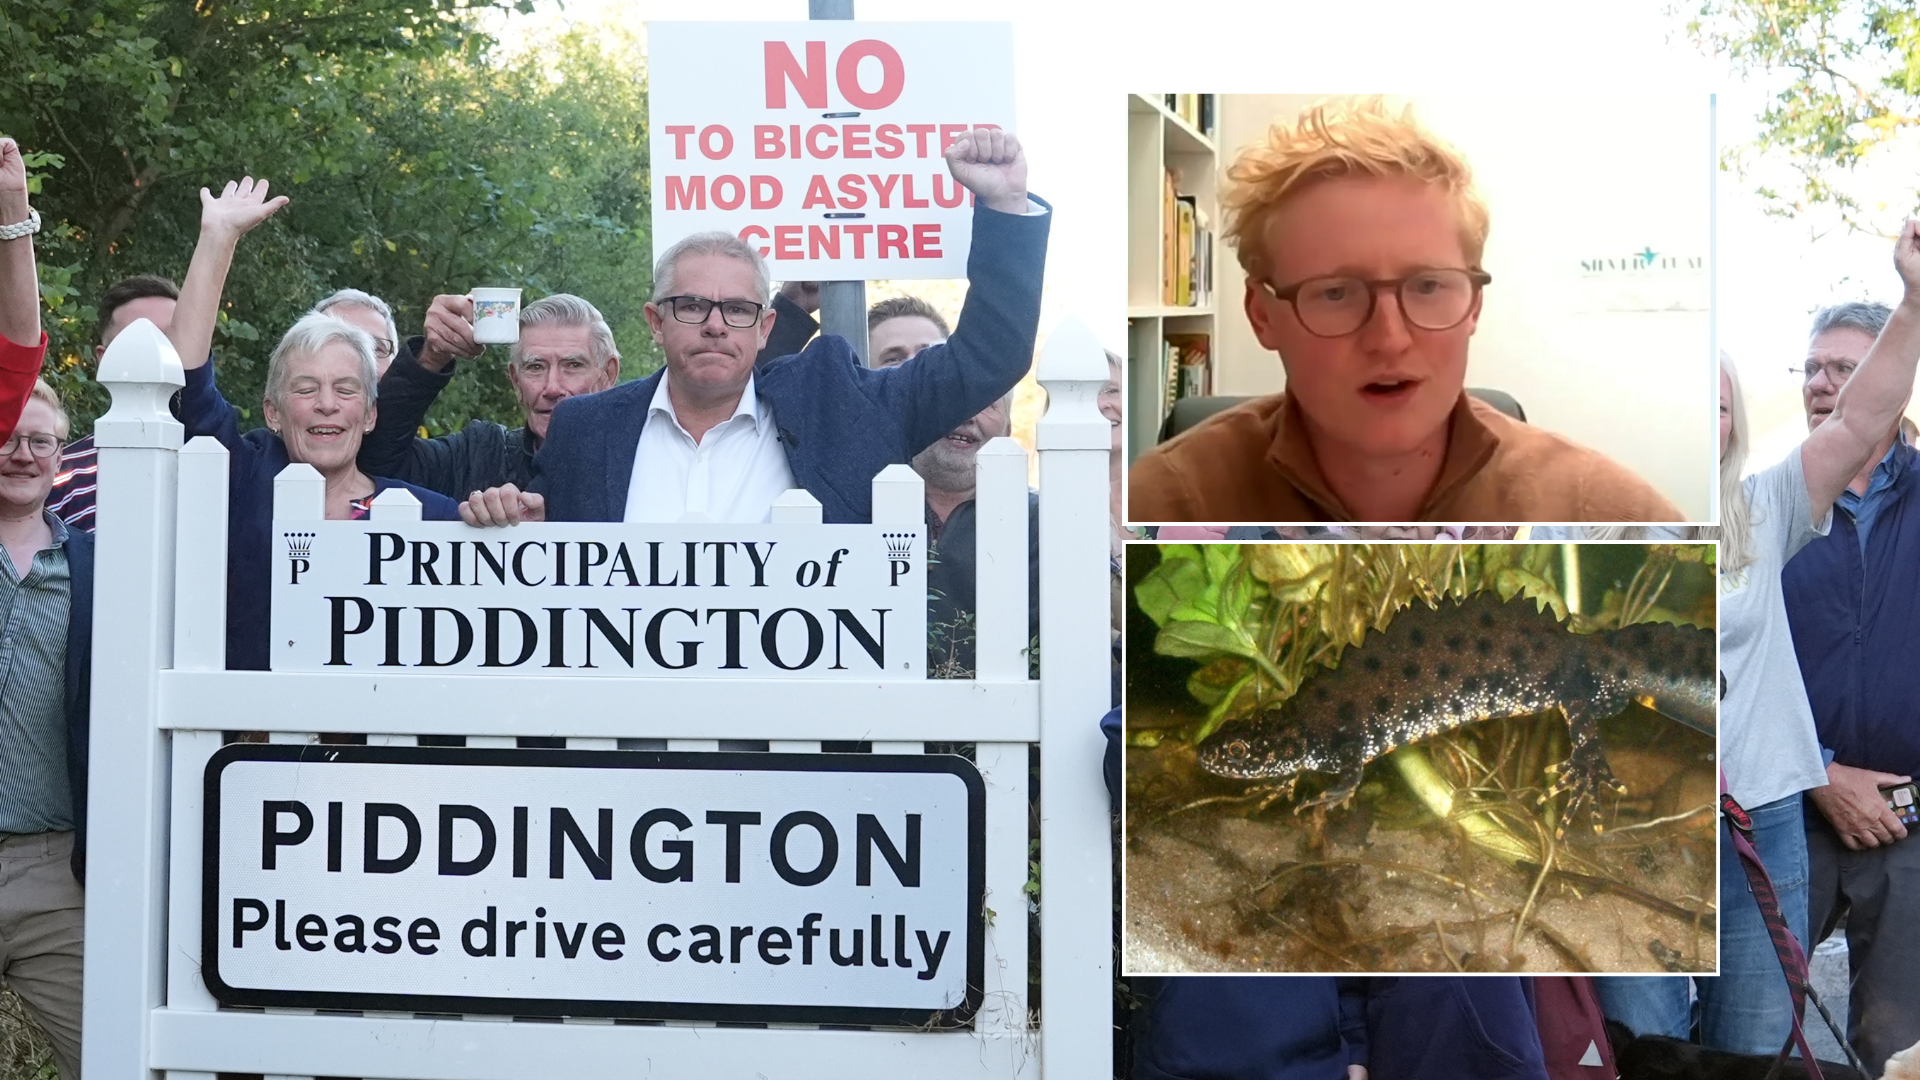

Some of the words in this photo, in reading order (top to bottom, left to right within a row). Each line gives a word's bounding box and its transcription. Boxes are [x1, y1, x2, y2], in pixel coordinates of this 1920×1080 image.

[765, 40, 905, 110] NO
[665, 125, 734, 160] TO
[754, 124, 1003, 160] BICESTE
[665, 175, 784, 211] MOD
[802, 174, 976, 209] ASYLU
[739, 224, 943, 260] CENTRE
[289, 559, 309, 585] P
[796, 548, 850, 588] of
[888, 560, 911, 587] P
[261, 800, 922, 888] PIDDINGTON
[232, 897, 441, 956] Please
[461, 906, 626, 961] drive
[647, 912, 951, 981] carefully
